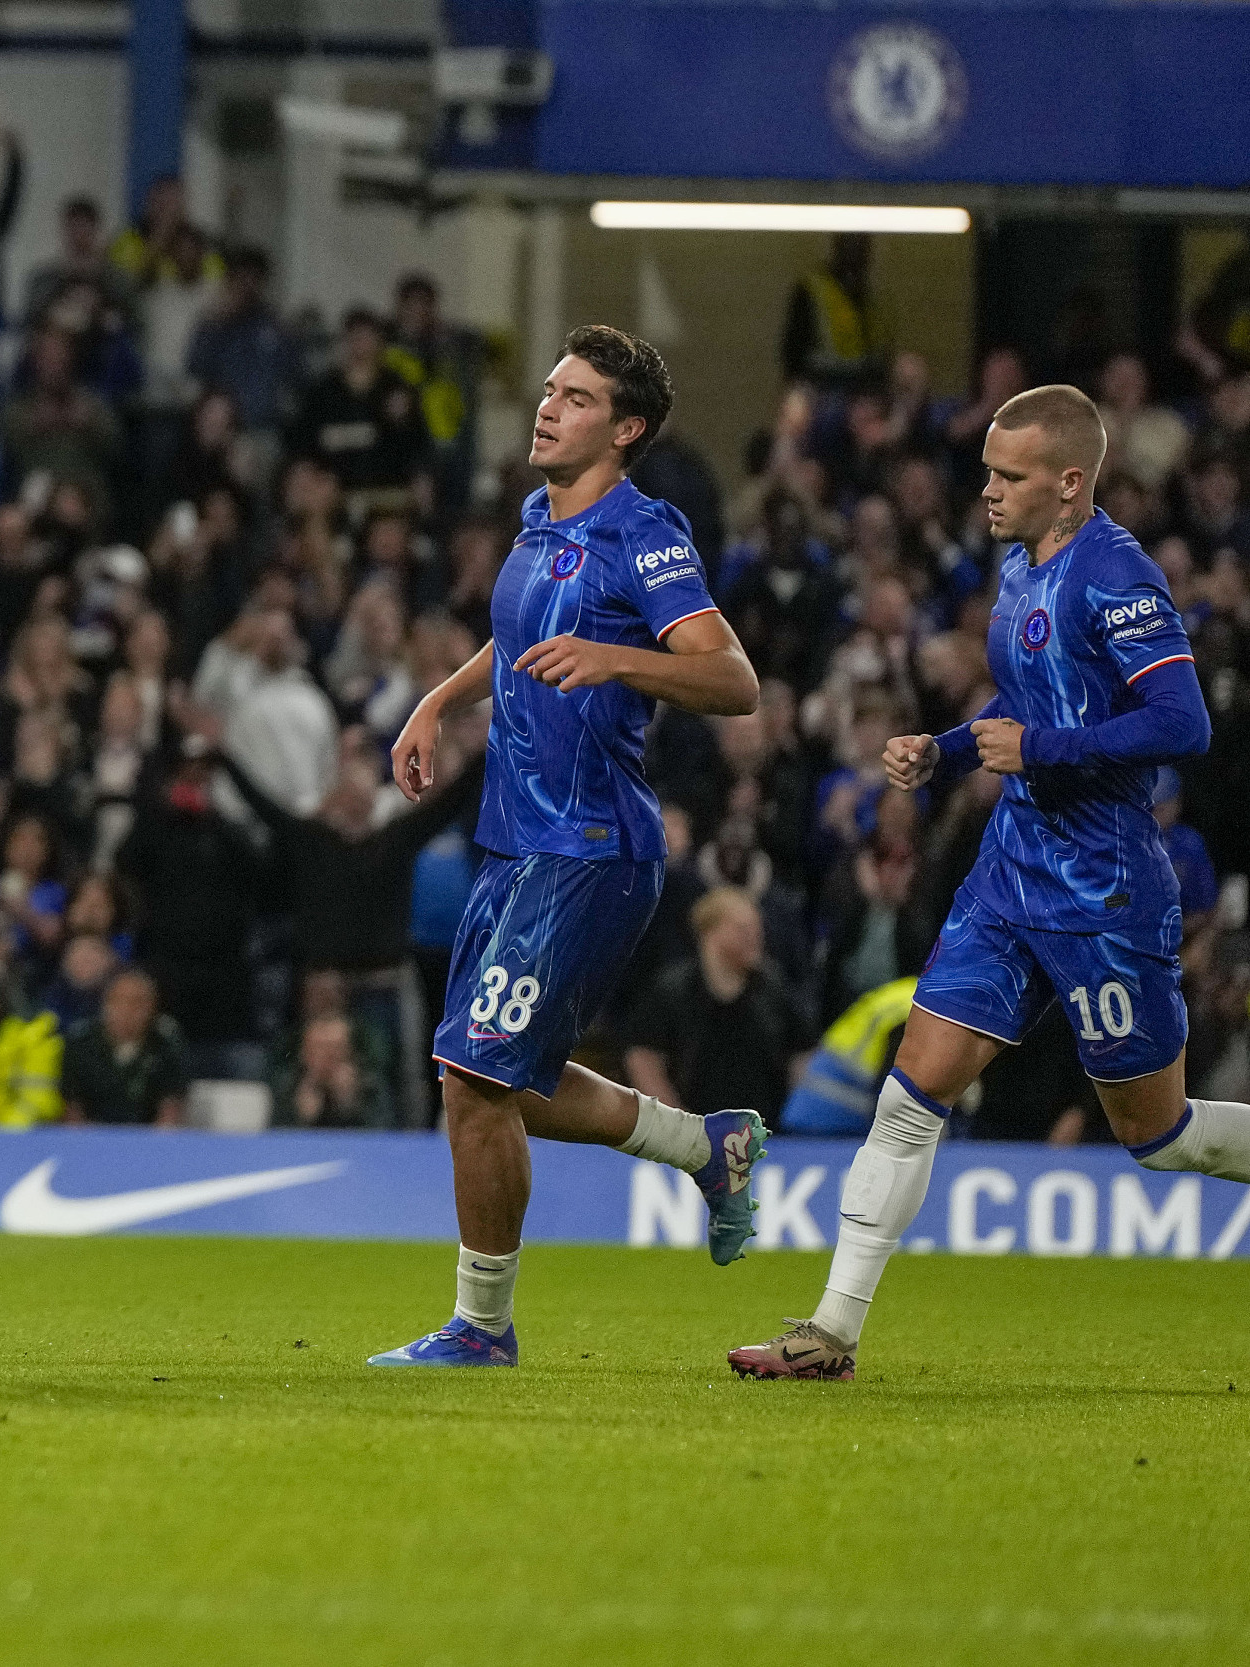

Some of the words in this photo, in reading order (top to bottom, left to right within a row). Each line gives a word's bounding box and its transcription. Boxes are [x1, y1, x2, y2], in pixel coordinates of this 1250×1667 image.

[635, 545, 690, 574] fever
[646, 566, 697, 588] feverup.com
[1104, 595, 1158, 629] fever
[1113, 618, 1164, 640] feverup.com
[470, 965, 541, 1033] 38
[1069, 981, 1134, 1041] 10
[628, 1157, 1250, 1260] NK.COM/
